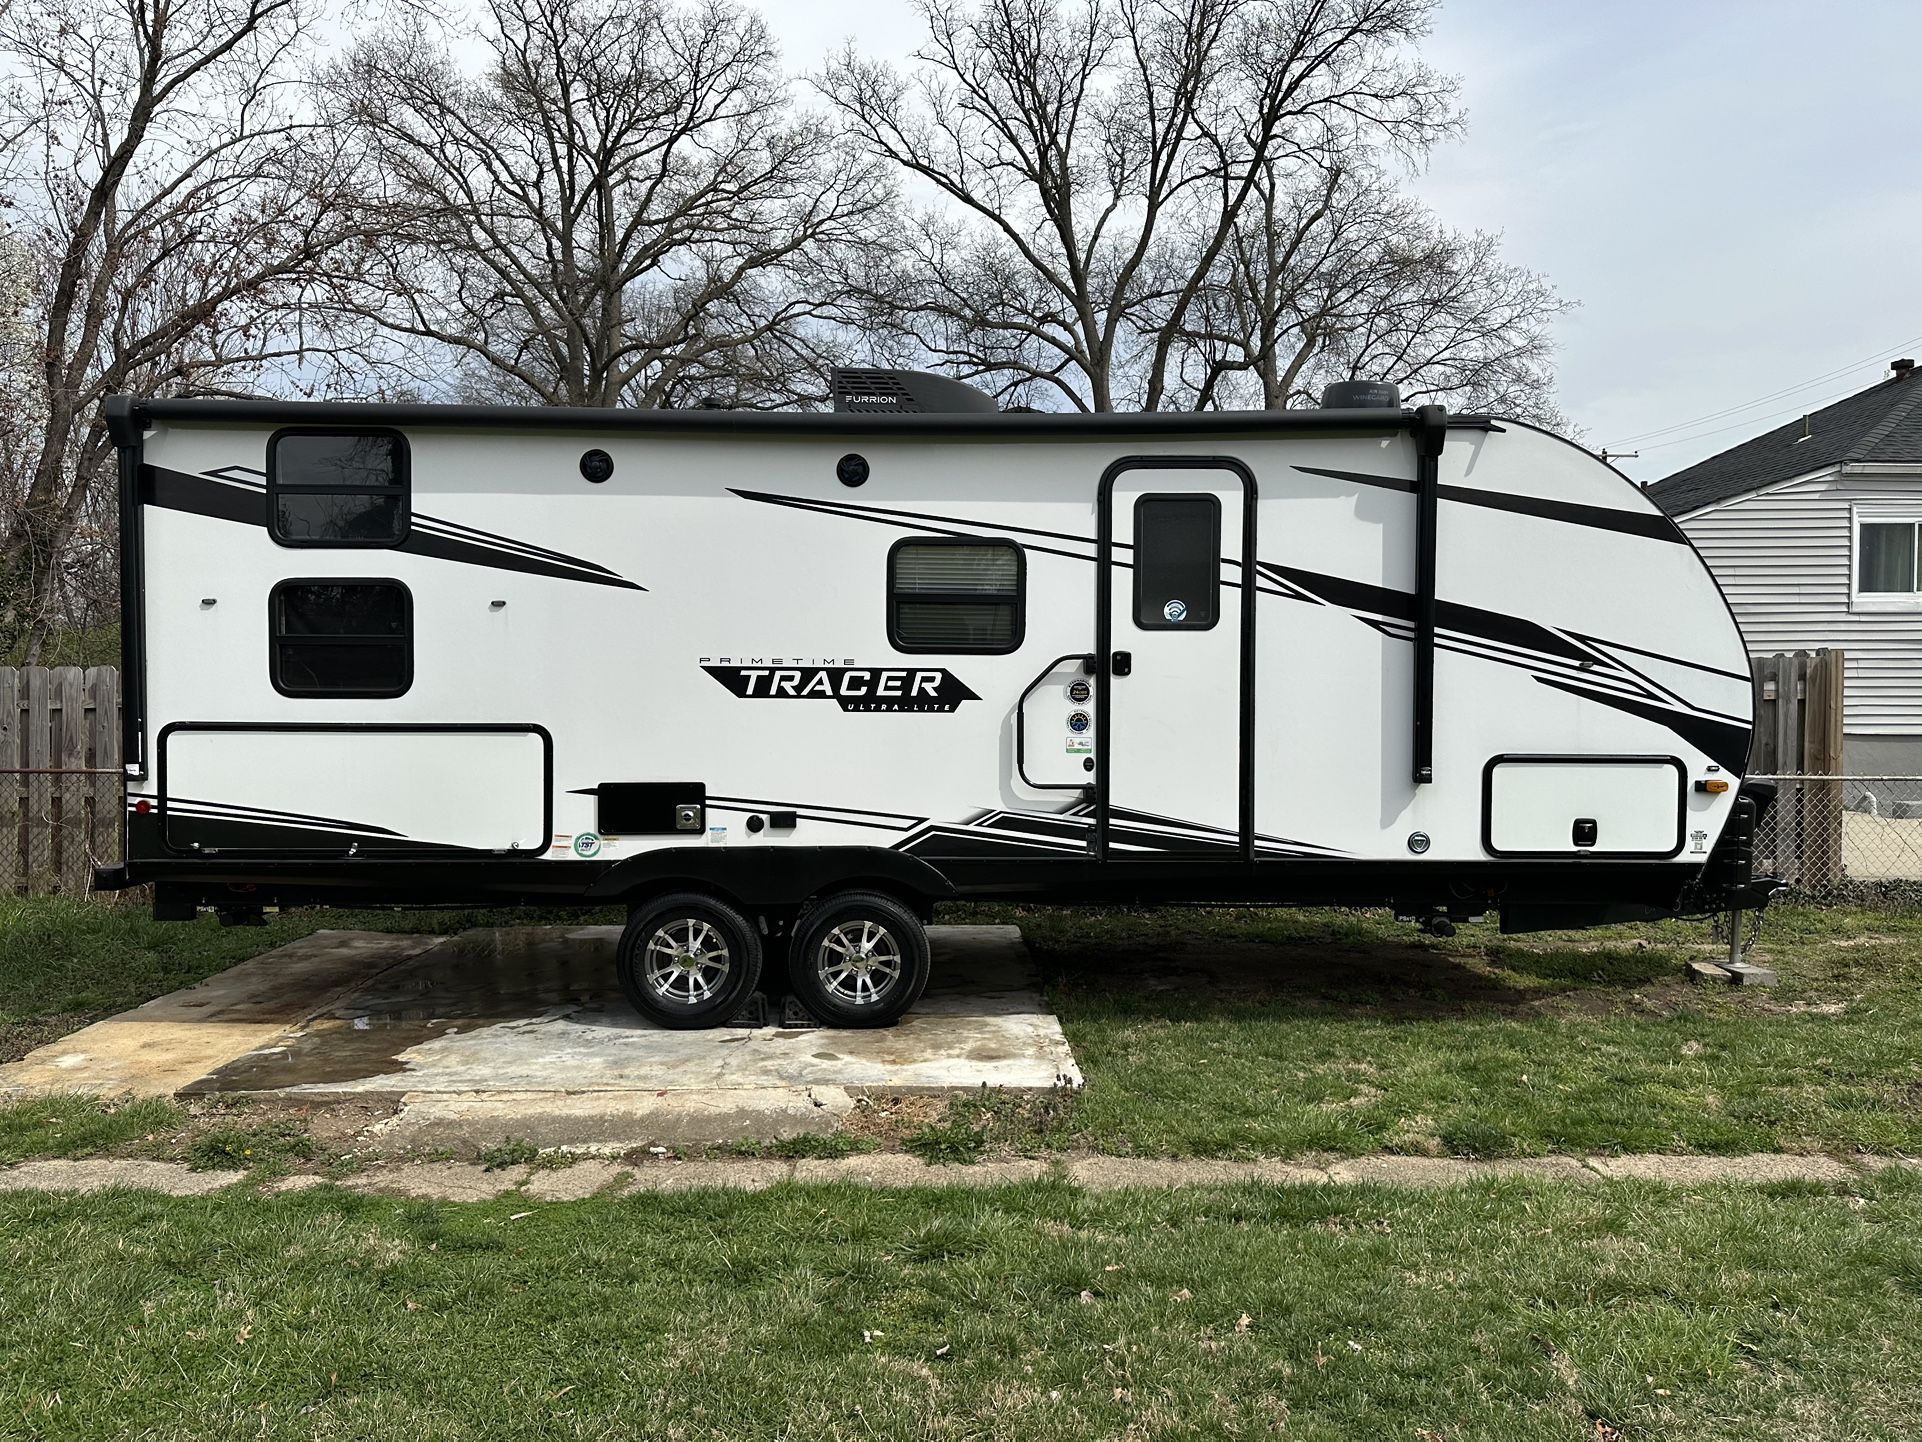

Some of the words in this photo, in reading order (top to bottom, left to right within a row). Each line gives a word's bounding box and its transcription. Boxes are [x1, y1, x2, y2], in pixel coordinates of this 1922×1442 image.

[845, 395, 896, 403] FURRION
[699, 657, 855, 666] PRIMETIME
[739, 669, 943, 697] TRACER
[847, 703, 951, 711] ULTRA-LITE
